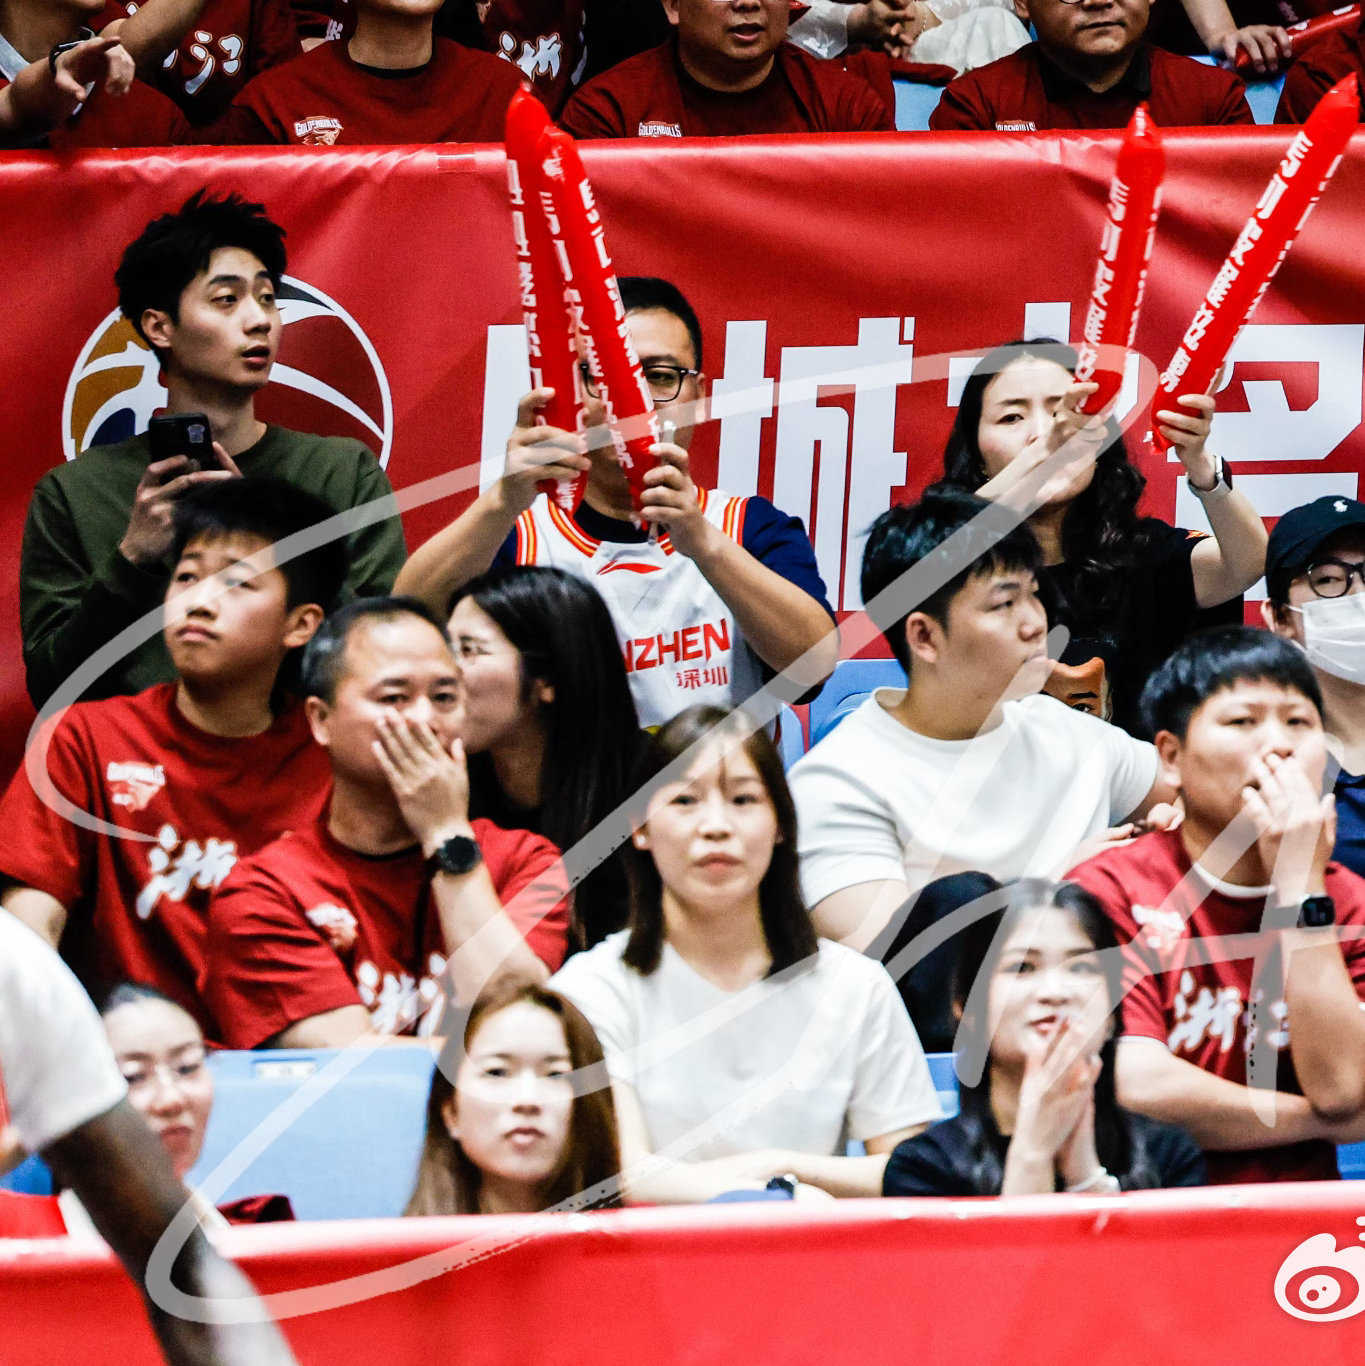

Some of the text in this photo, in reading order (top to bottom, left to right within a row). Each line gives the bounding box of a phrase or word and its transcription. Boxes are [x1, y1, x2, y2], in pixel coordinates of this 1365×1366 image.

[624, 617, 732, 674] NZHEN
[676, 665, 729, 692] 深圳
[137, 823, 238, 921] 浙
